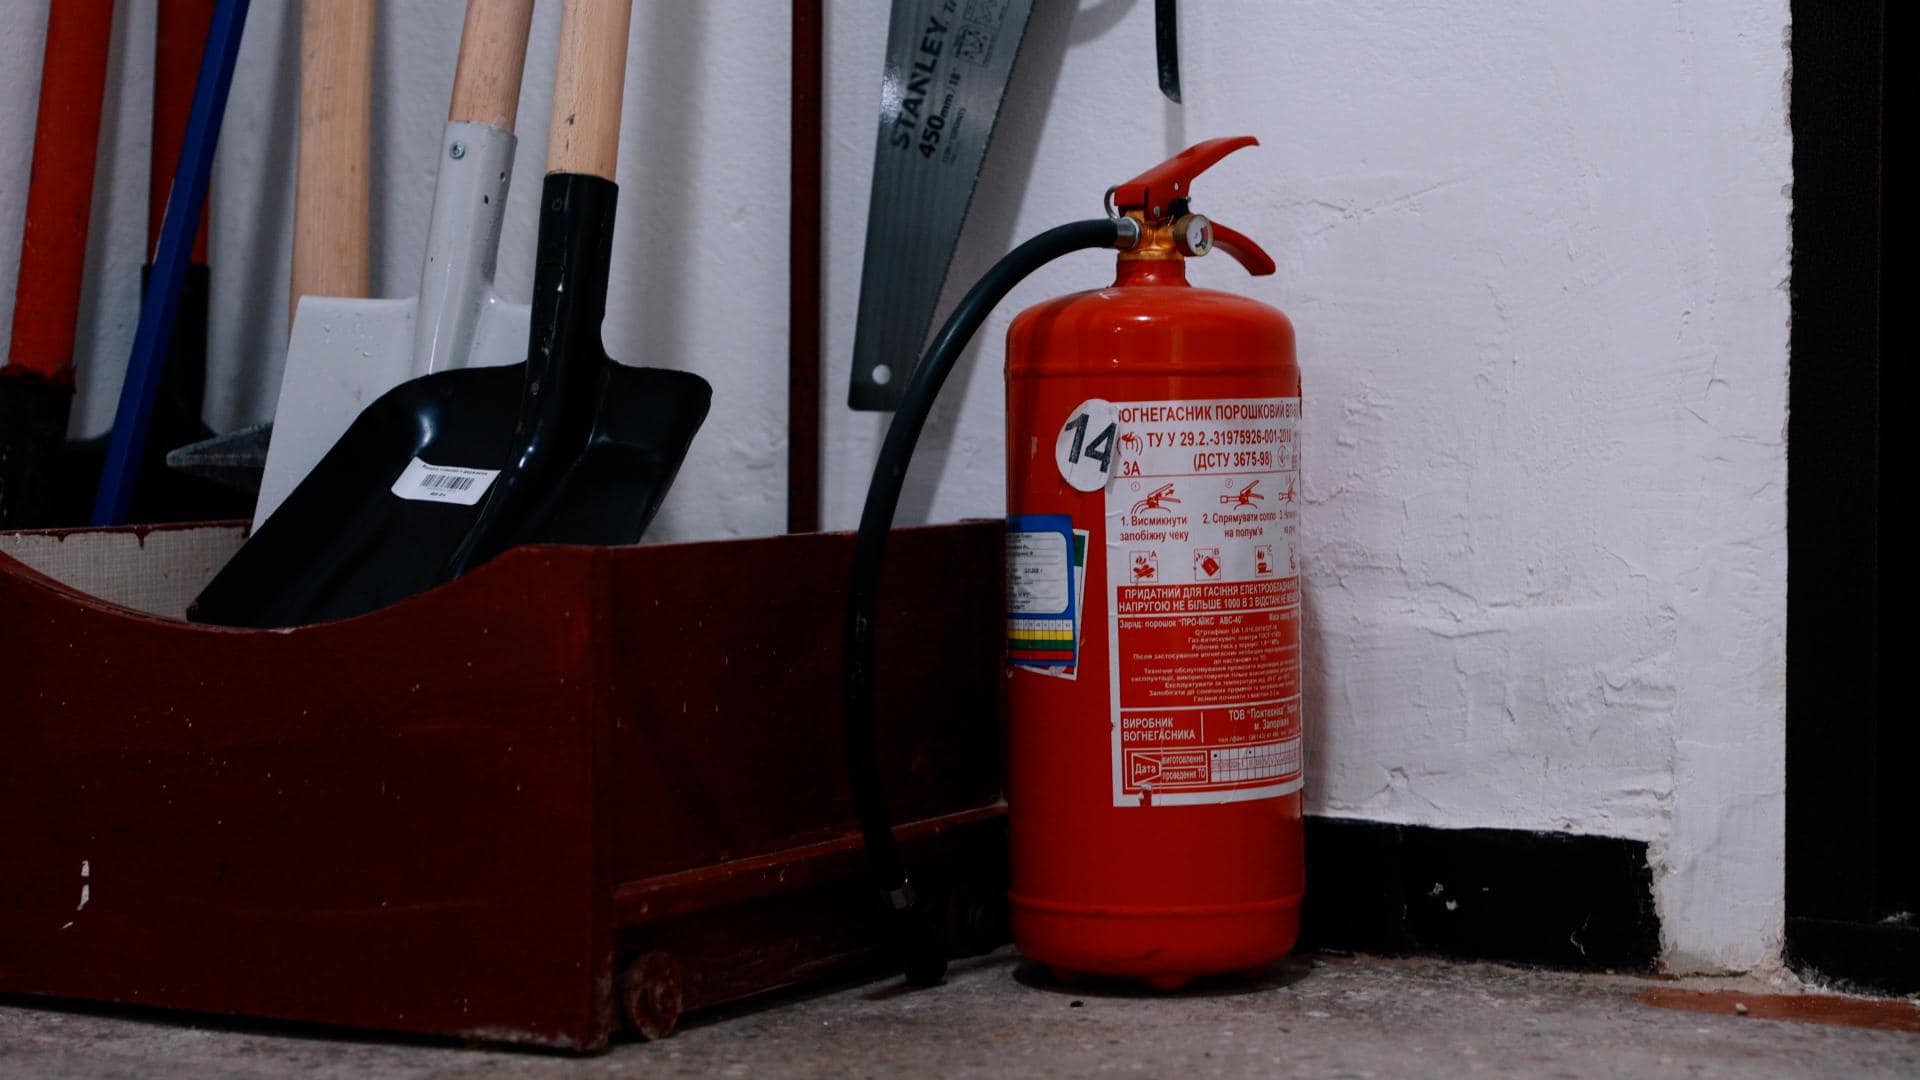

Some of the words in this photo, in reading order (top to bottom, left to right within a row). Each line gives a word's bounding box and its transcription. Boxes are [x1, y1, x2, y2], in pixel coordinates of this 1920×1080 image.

[890, 16, 948, 151] STANLEY
[1215, 402, 1285, 421] ПОРОШКОВИЙ
[1065, 413, 1117, 474] 14
[1147, 433, 1164, 447] ТУ
[1167, 433, 1176, 447] У
[1193, 453, 1230, 471] (ДСТУ
[1233, 451, 1272, 468] 3675-98)
[1121, 516, 1128, 527] 1.
[1131, 514, 1187, 528] Висмикнути
[1202, 514, 1210, 524] 2.
[1212, 513, 1258, 526] Спрямувати
[1120, 531, 1166, 543] запобіжну
[1169, 531, 1189, 542] чеку
[1224, 529, 1234, 538] на
[1125, 586, 1181, 600] ПРИДАТНИЙ
[1183, 587, 1202, 598] ДЛЯ
[1204, 586, 1238, 597] ГАСІННЯ
[1119, 601, 1171, 612] НАПРУГОЮ
[1173, 600, 1185, 611] НЕ
[1187, 599, 1221, 610] БІЛЬШЕ
[1224, 599, 1241, 609] 1000
[1229, 709, 1245, 720] ТОВ
[1123, 718, 1174, 729] ВИРОБНИК
[1123, 729, 1196, 741] ВОГНЕГАСНИКА
[1135, 763, 1157, 775] Дата
